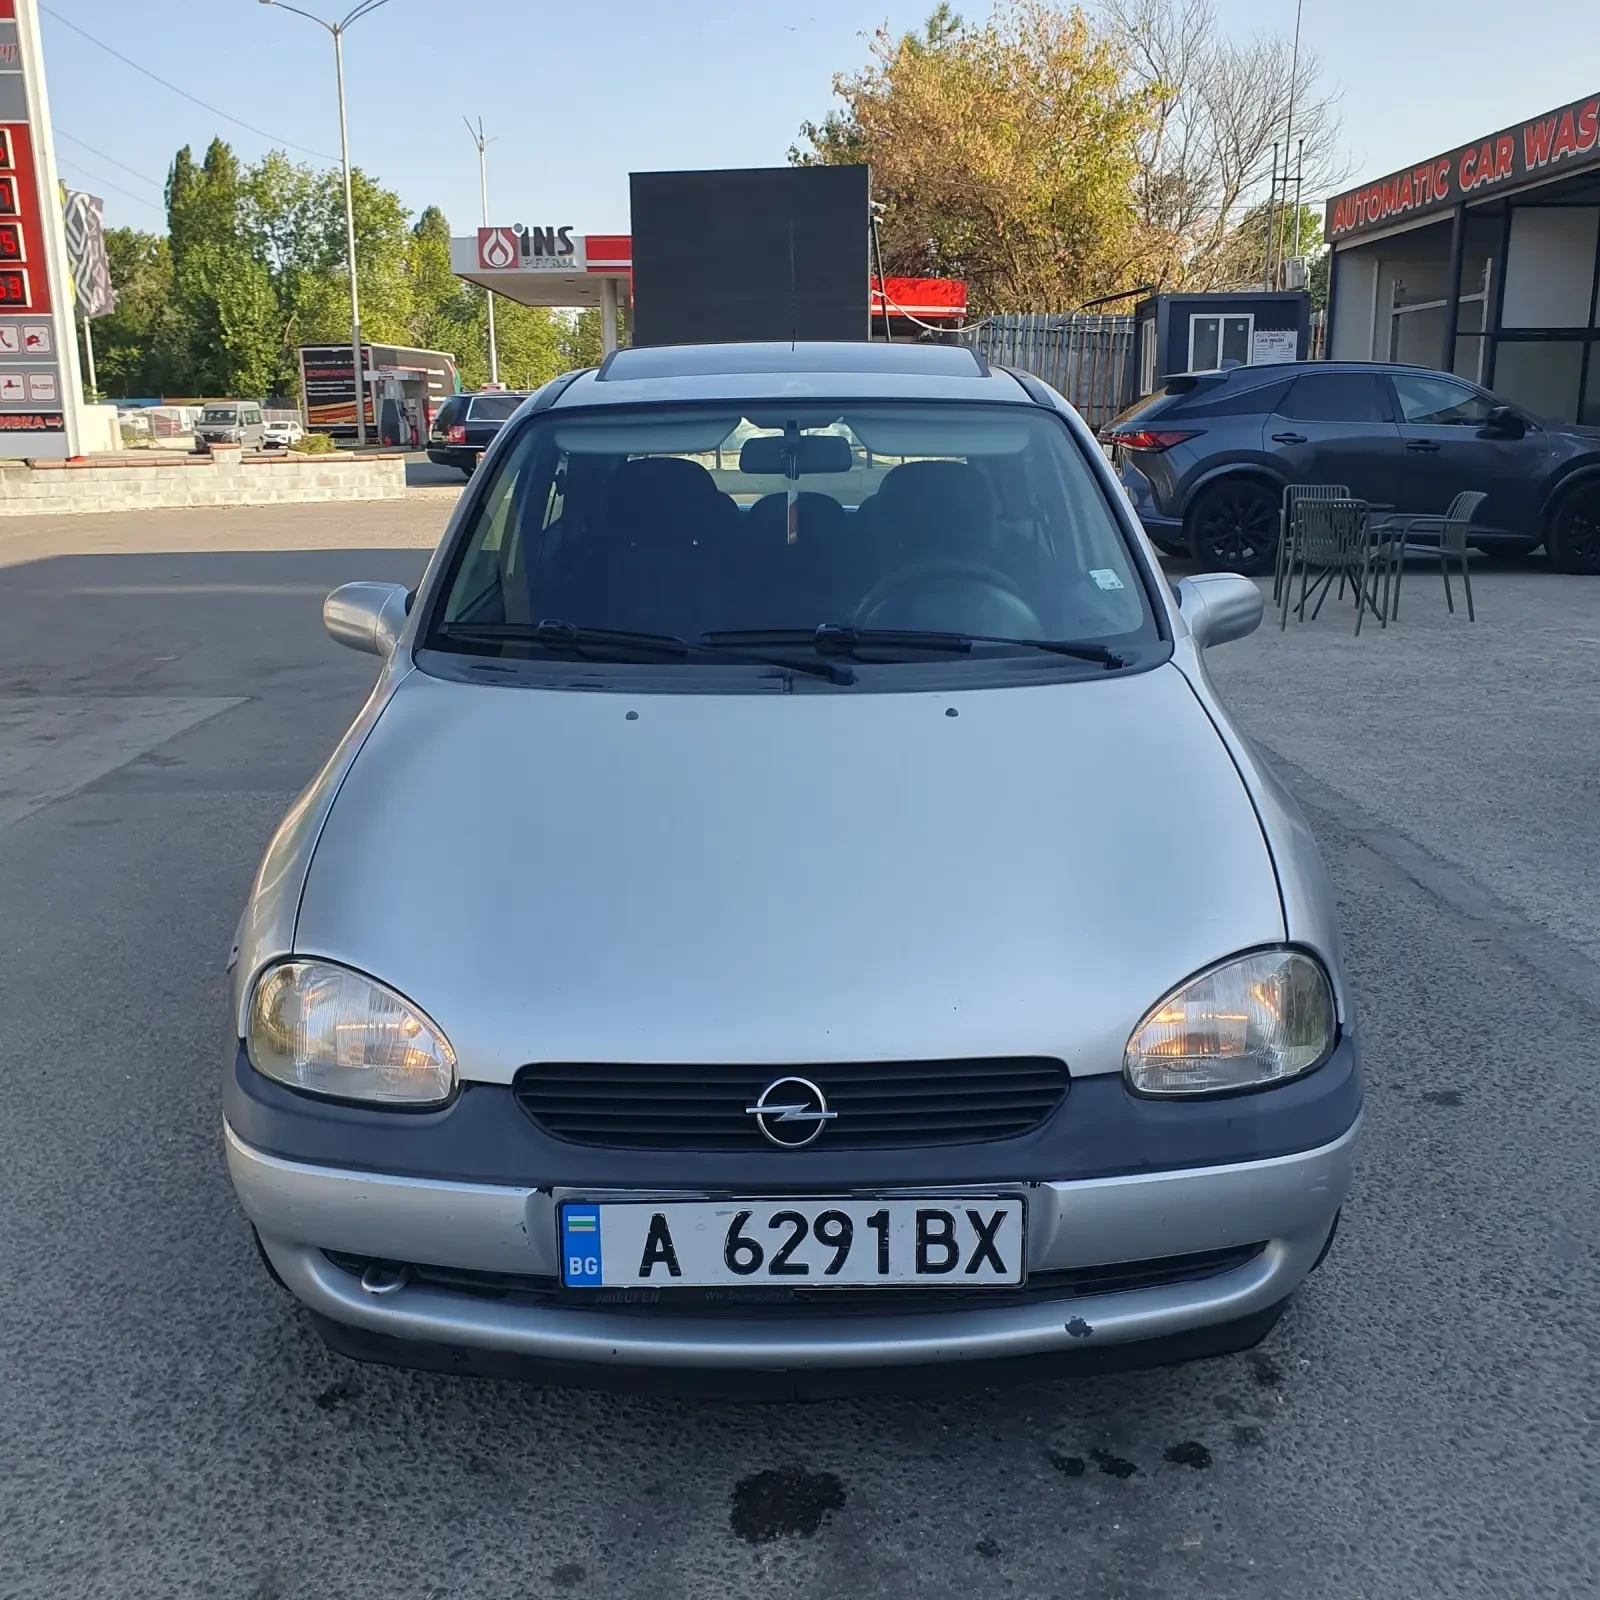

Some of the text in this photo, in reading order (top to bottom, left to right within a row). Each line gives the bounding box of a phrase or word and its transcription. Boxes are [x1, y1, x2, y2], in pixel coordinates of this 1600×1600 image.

[1332, 100, 1600, 235] AUTOMATIC CAR WAS
[513, 223, 575, 257] INS
[569, 1257, 598, 1276] BG
[638, 1212, 682, 1278] A
[724, 1208, 890, 1276] 6291
